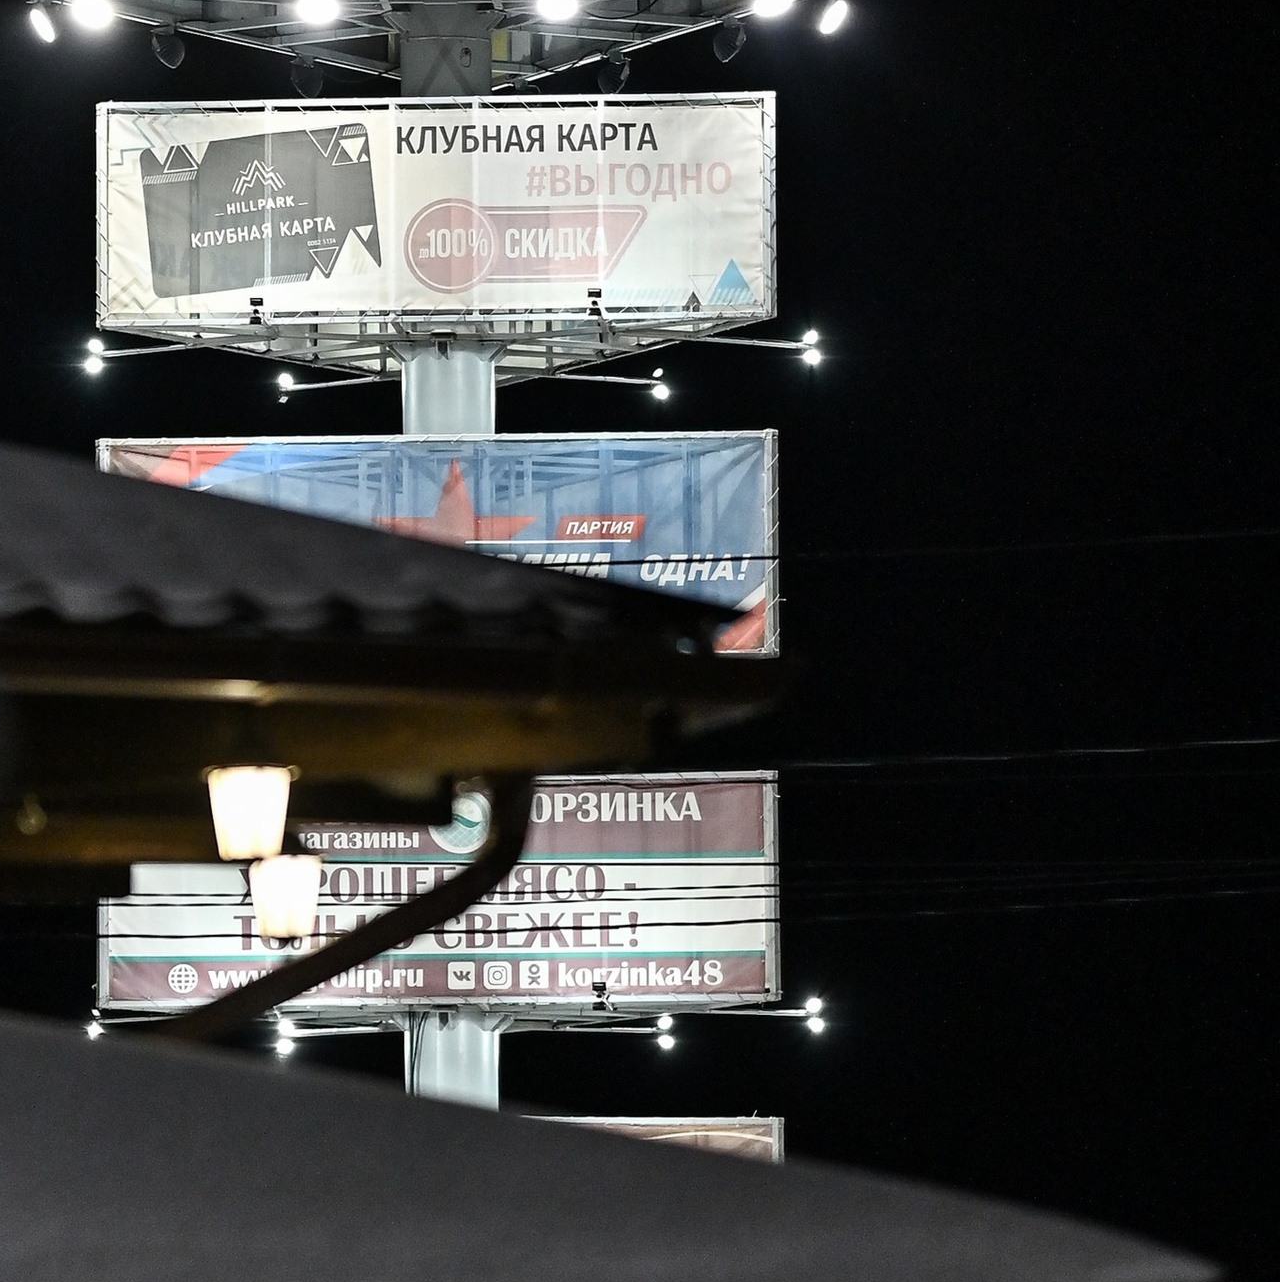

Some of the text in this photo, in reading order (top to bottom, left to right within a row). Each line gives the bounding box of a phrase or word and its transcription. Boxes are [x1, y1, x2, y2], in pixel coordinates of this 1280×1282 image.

[395, 122, 659, 154] КЛУБНАЯ КАРТА
[525, 161, 732, 202] #ВЫГОДНО
[226, 195, 295, 215] HILLPARK
[191, 216, 336, 248] КЛУБНАЯ КАРТА
[426, 228, 488, 258] 100%
[504, 226, 609, 261] СКИДКА
[565, 521, 634, 535] ПАРТИЯ
[639, 553, 752, 586] ОДНА!
[529, 791, 702, 823] ОРЗИНКА
[434, 912, 639, 949] СВЕЖЕЕ!
[558, 959, 724, 988] korzinka48
